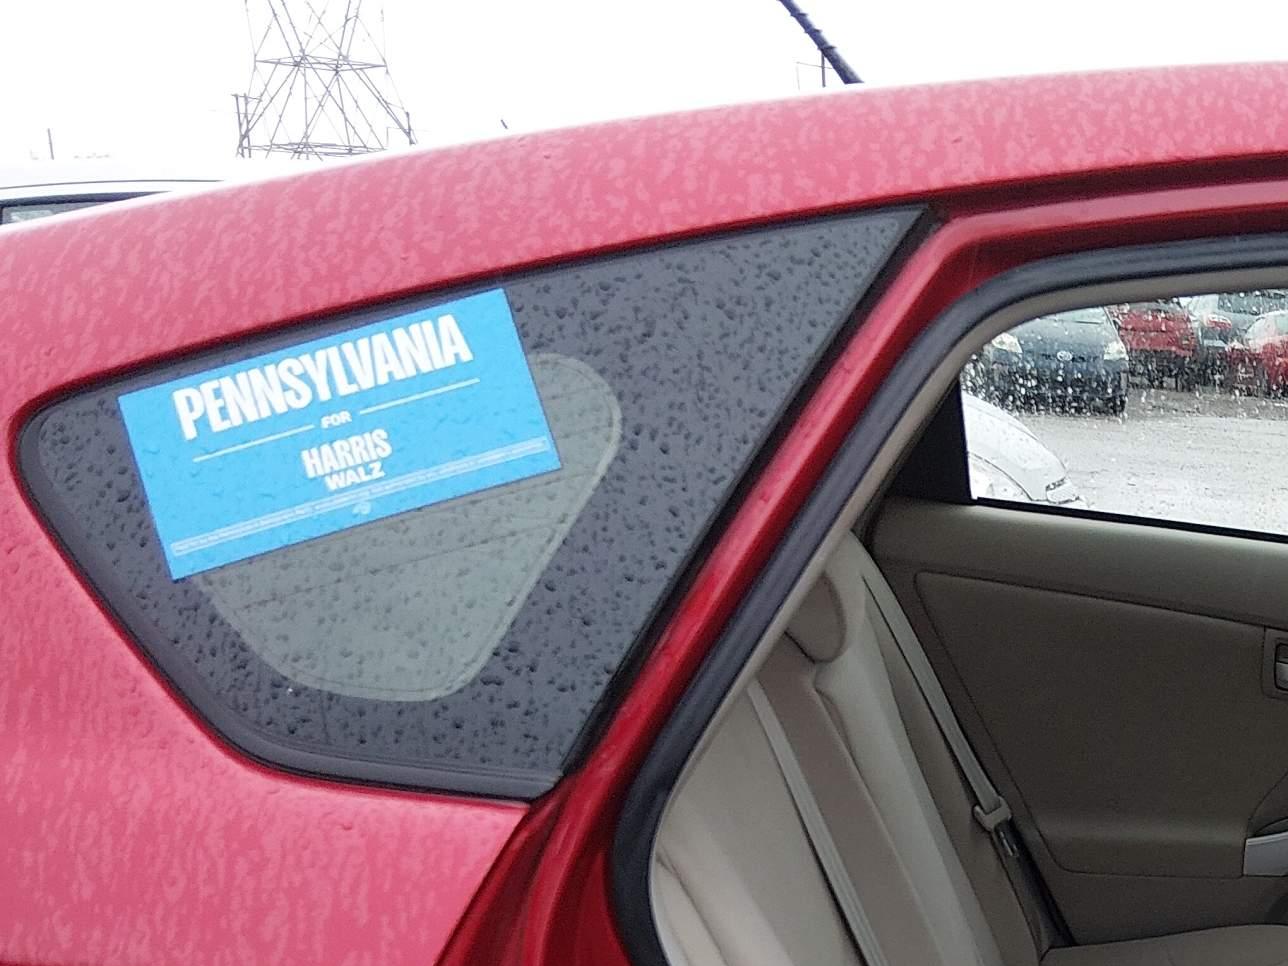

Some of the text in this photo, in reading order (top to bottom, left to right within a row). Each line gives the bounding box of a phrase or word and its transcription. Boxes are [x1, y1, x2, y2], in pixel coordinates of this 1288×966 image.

[172, 313, 475, 441] PENNSYLVANIA
[320, 410, 353, 430] FOR
[301, 429, 393, 478] HARRIS
[323, 463, 387, 492] WALZ
